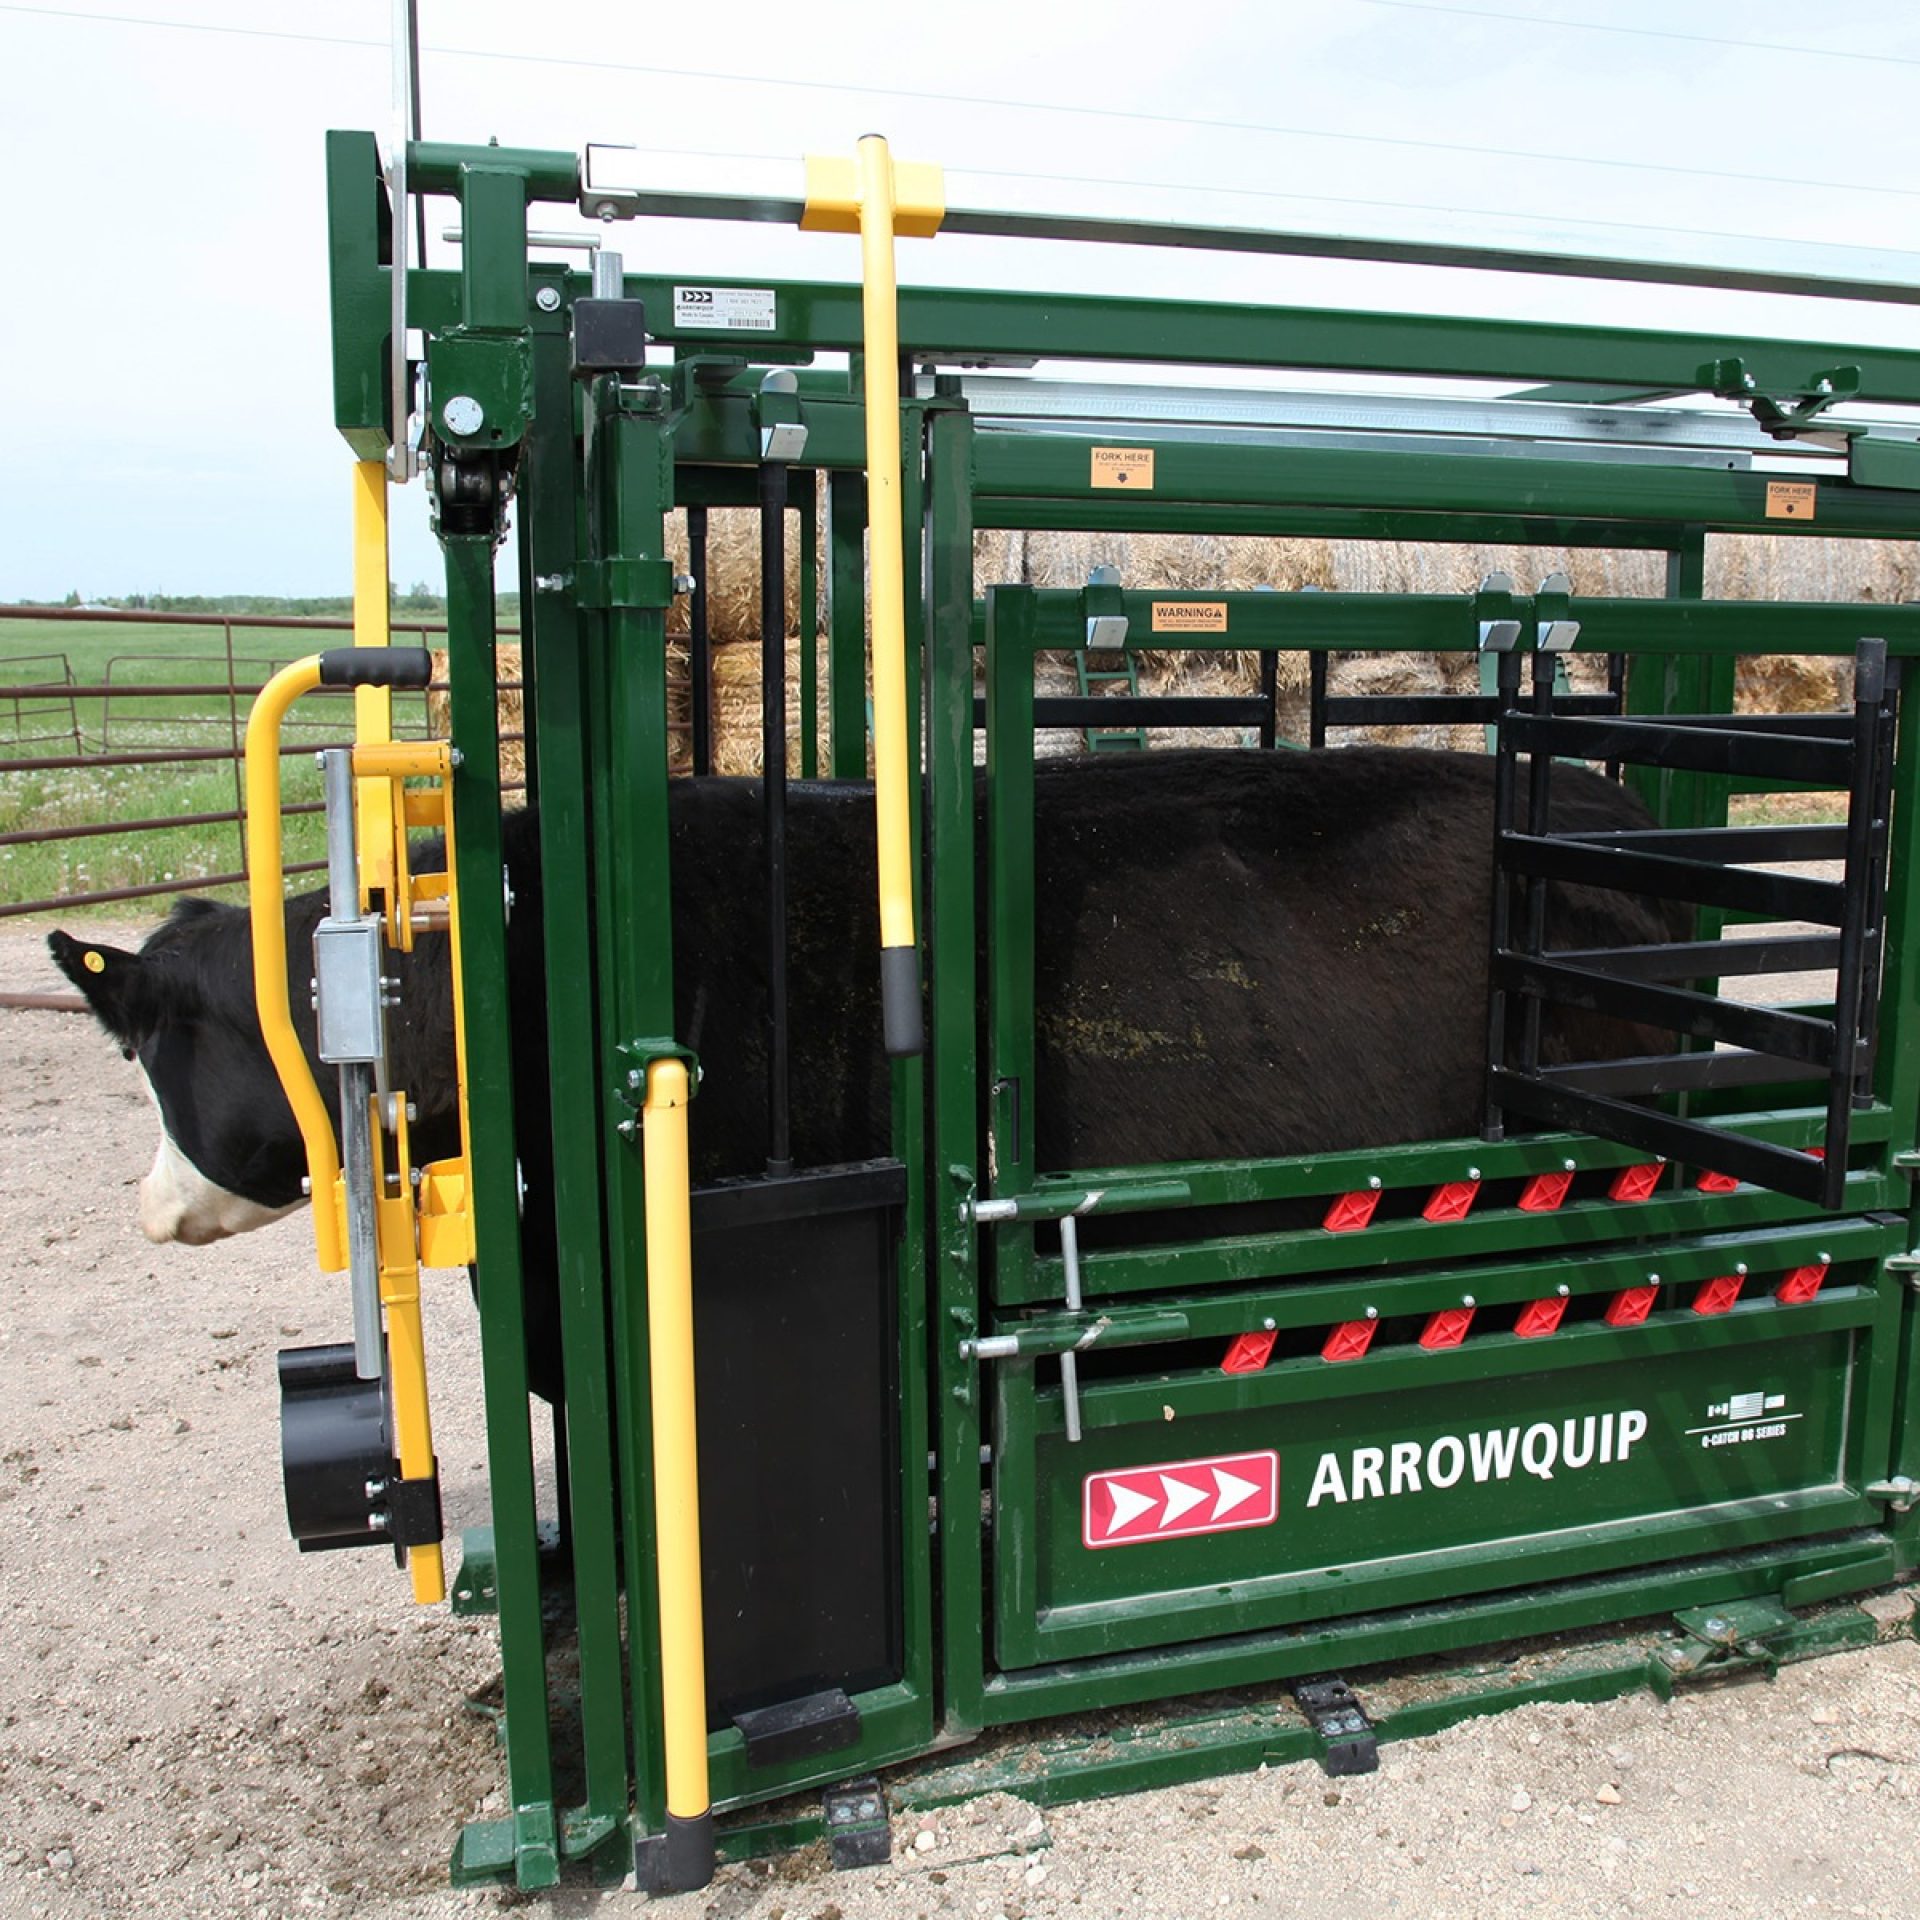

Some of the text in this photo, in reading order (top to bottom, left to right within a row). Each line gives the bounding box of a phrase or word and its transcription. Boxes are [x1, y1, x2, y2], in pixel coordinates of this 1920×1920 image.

[1095, 452, 1150, 463] FORK HERE
[1770, 485, 1812, 496] FORK HERE
[1156, 607, 1213, 618] WARNING
[1755, 1423, 1787, 1439] SERIES
[1306, 1409, 1648, 1508] ARROWQUIP
